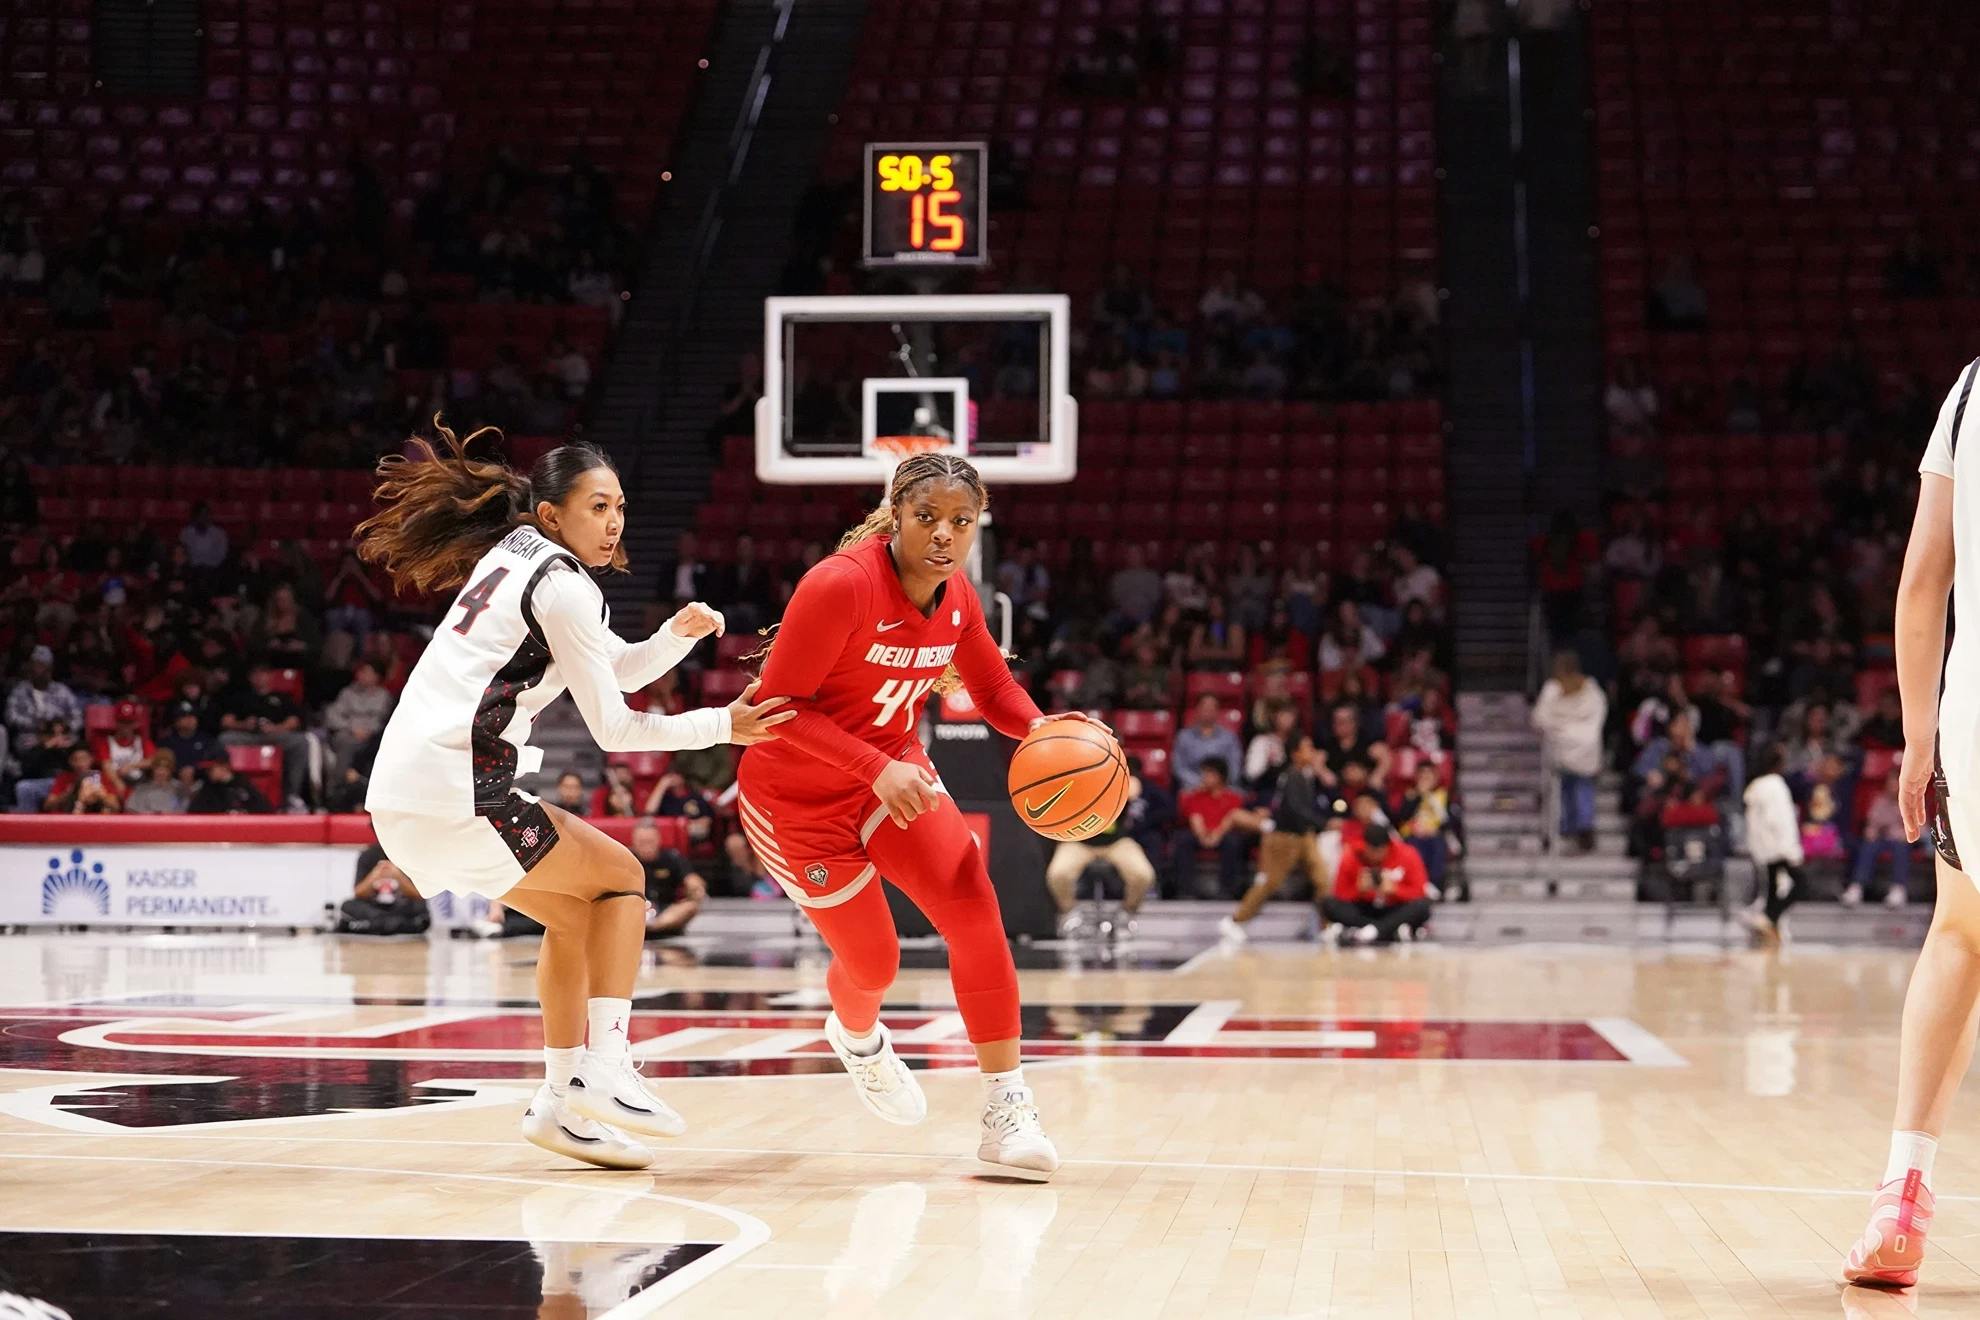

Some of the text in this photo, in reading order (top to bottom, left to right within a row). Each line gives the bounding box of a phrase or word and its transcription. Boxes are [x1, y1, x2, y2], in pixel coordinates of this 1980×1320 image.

[910, 191, 964, 250] 15
[453, 566, 510, 635] 4
[864, 643, 915, 669] NEW
[872, 678, 936, 733] 44
[935, 724, 990, 740] TOYOTA
[126, 868, 198, 888] KAISER
[126, 895, 273, 916] PERMANENTE
